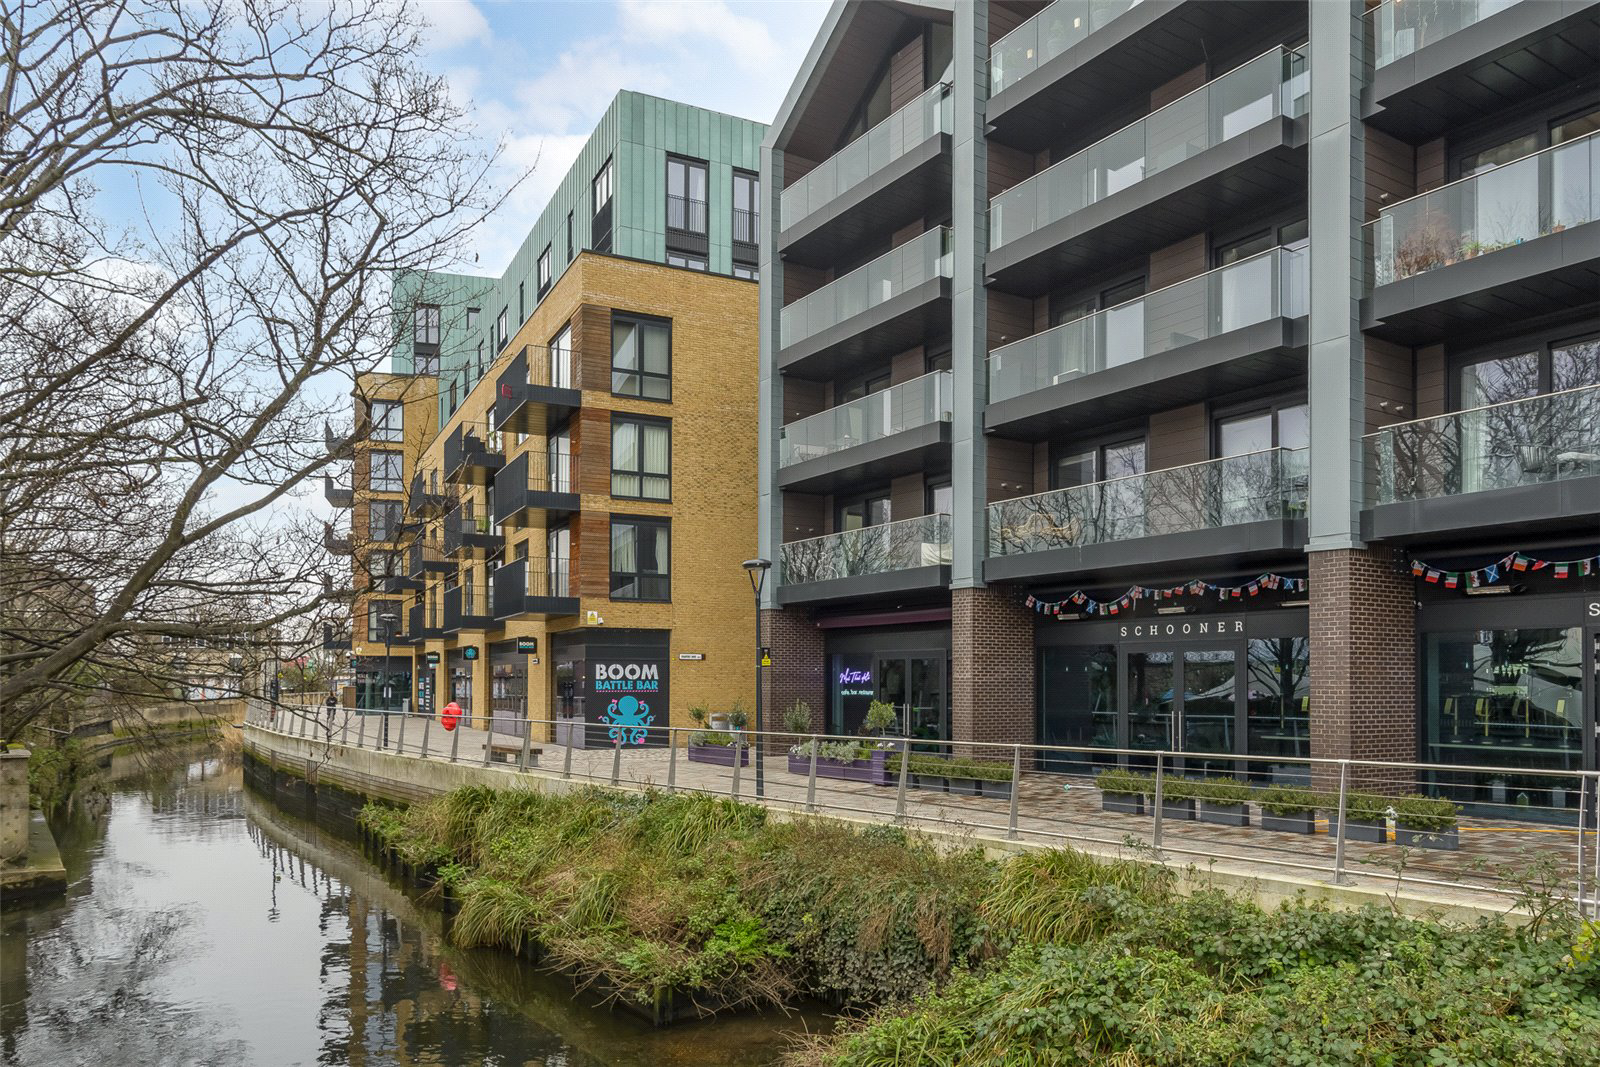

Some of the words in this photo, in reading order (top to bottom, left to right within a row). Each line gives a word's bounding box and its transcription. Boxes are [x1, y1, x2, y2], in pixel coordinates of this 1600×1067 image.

[1120, 621, 1244, 637] SCHOONER
[595, 664, 659, 680] BOOM
[595, 680, 634, 690] BATTLE
[636, 680, 659, 690] BAR
